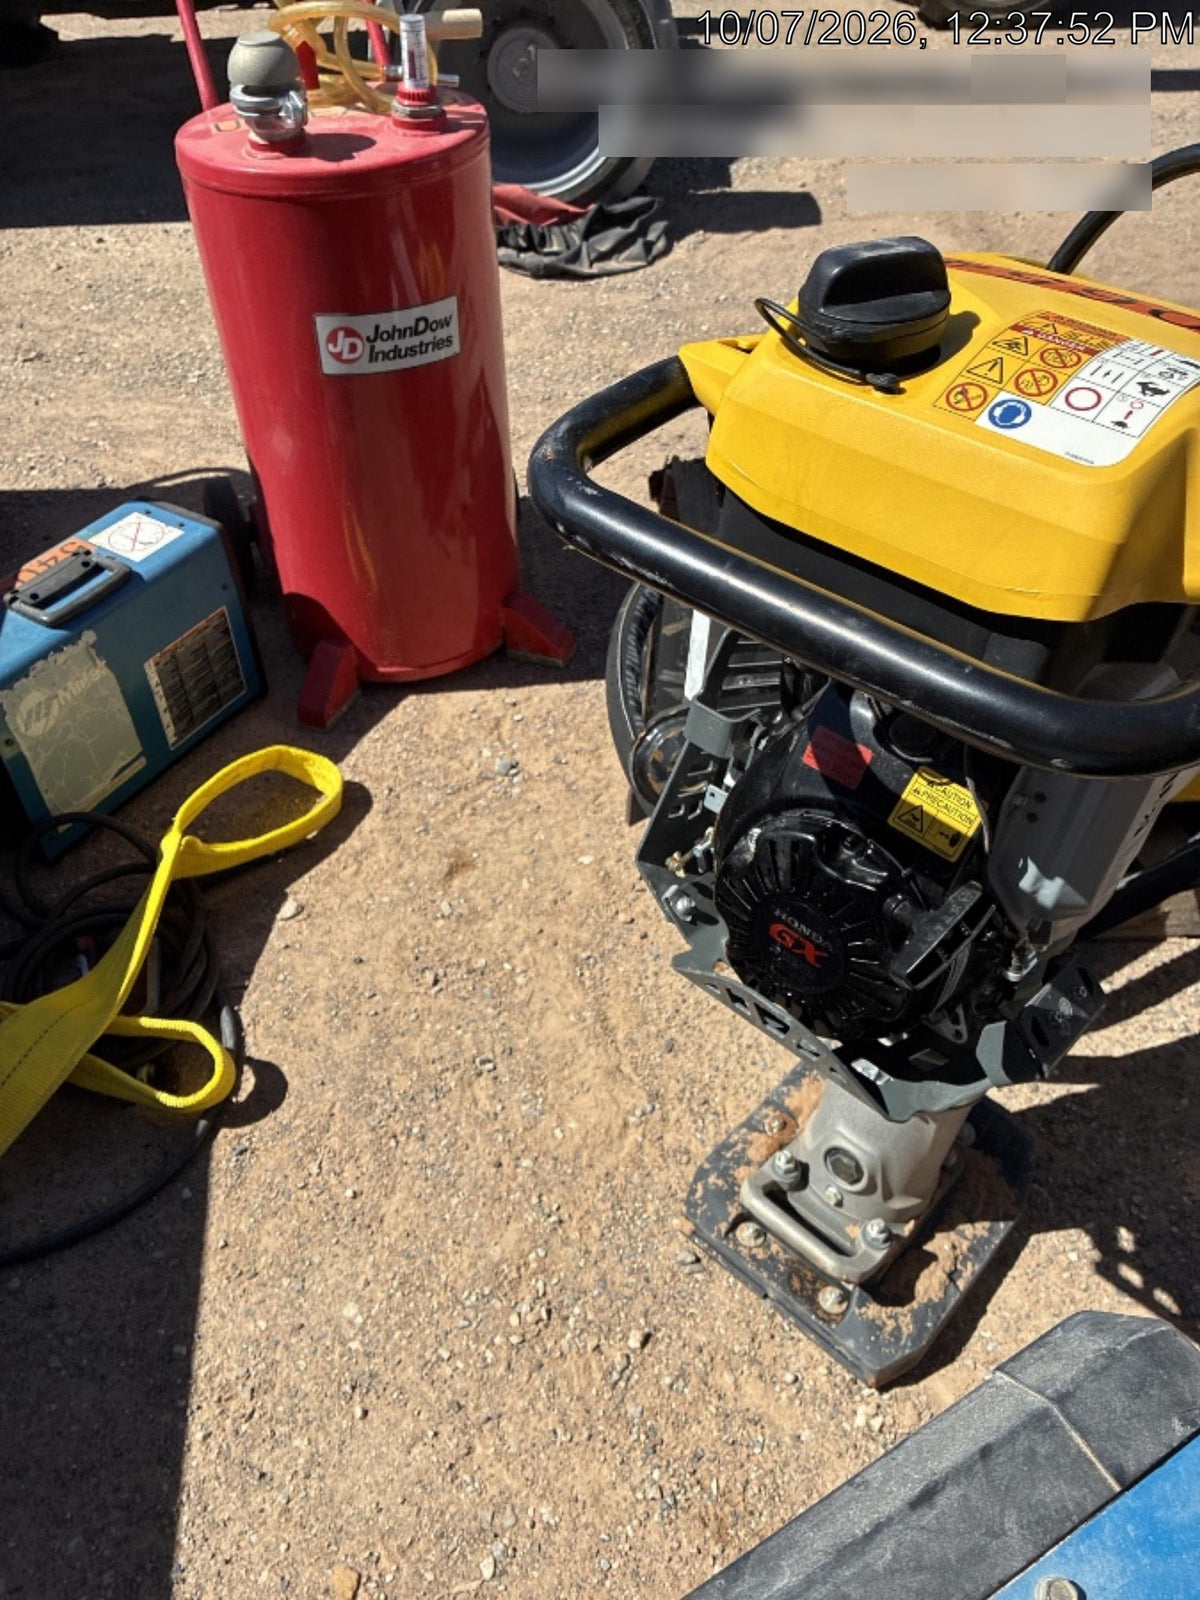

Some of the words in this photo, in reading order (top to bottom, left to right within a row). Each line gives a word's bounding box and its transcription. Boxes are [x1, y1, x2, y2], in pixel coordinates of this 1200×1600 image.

[366, 314, 453, 344] JohnDow
[328, 330, 363, 360] JD
[368, 335, 454, 363] Industries
[921, 790, 976, 826] PRECAUTION
[934, 784, 972, 810] CAUTION
[773, 907, 833, 952] HONDA
[769, 923, 829, 968] GX
